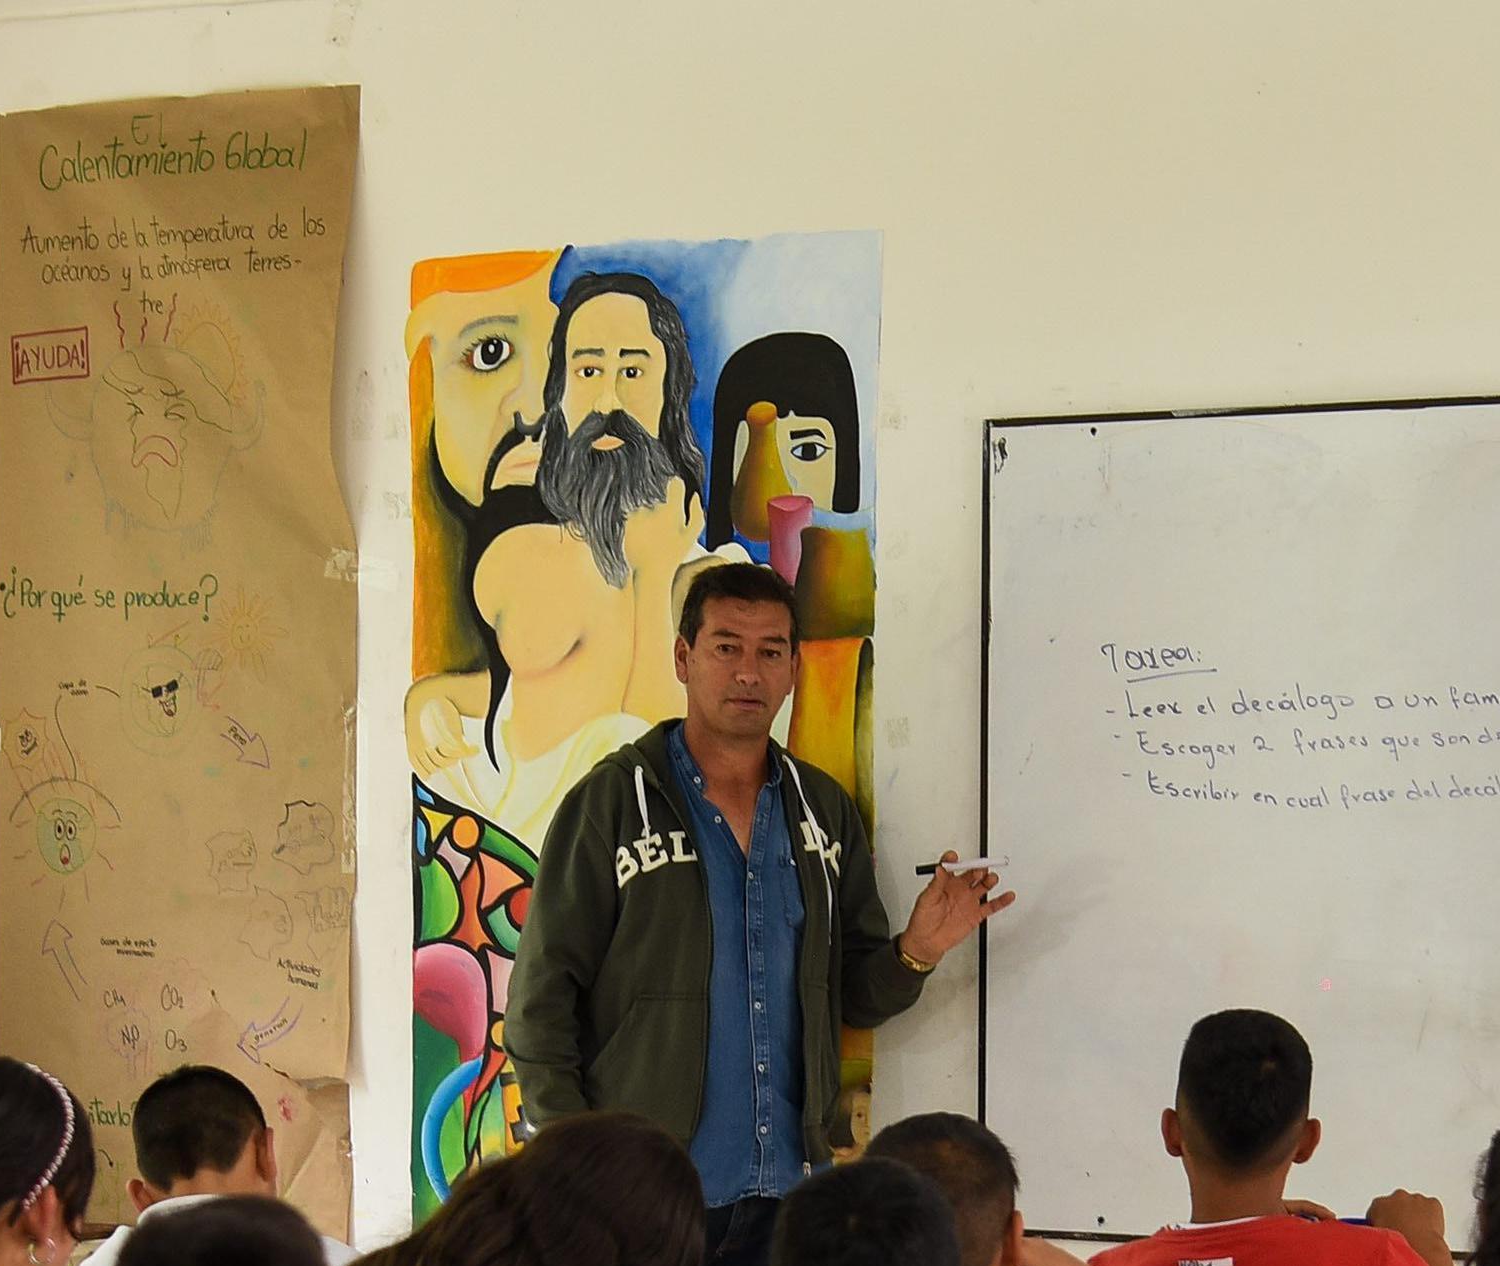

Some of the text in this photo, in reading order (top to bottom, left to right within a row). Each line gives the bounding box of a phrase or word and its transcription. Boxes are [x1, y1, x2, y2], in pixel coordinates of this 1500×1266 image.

[131, 112, 168, 147] El
[39, 127, 307, 191] Calentamiento Global
[20, 206, 326, 257] Aumento de la temperatura de los
[121, 265, 132, 292] y
[15, 338, 86, 380] ¡AYUDA!
[51, 574, 87, 623] qué
[94, 590, 116, 609] se
[124, 573, 219, 623] produce?
[1100, 643, 1203, 673] Tarea:
[1124, 690, 1182, 718] Leer
[1197, 696, 1216, 715] el
[1232, 682, 1355, 720] decálogo
[1374, 694, 1394, 710] a
[1404, 695, 1438, 708] un
[1136, 730, 1236, 770] Escoger
[1253, 735, 1275, 752] 2
[1294, 727, 1369, 756] frases
[1381, 736, 1420, 762] que
[1147, 769, 1240, 801] Escribir
[1253, 791, 1278, 806] en
[1286, 786, 1331, 808] cual
[1341, 784, 1395, 810] frase
[1406, 779, 1442, 801] del
